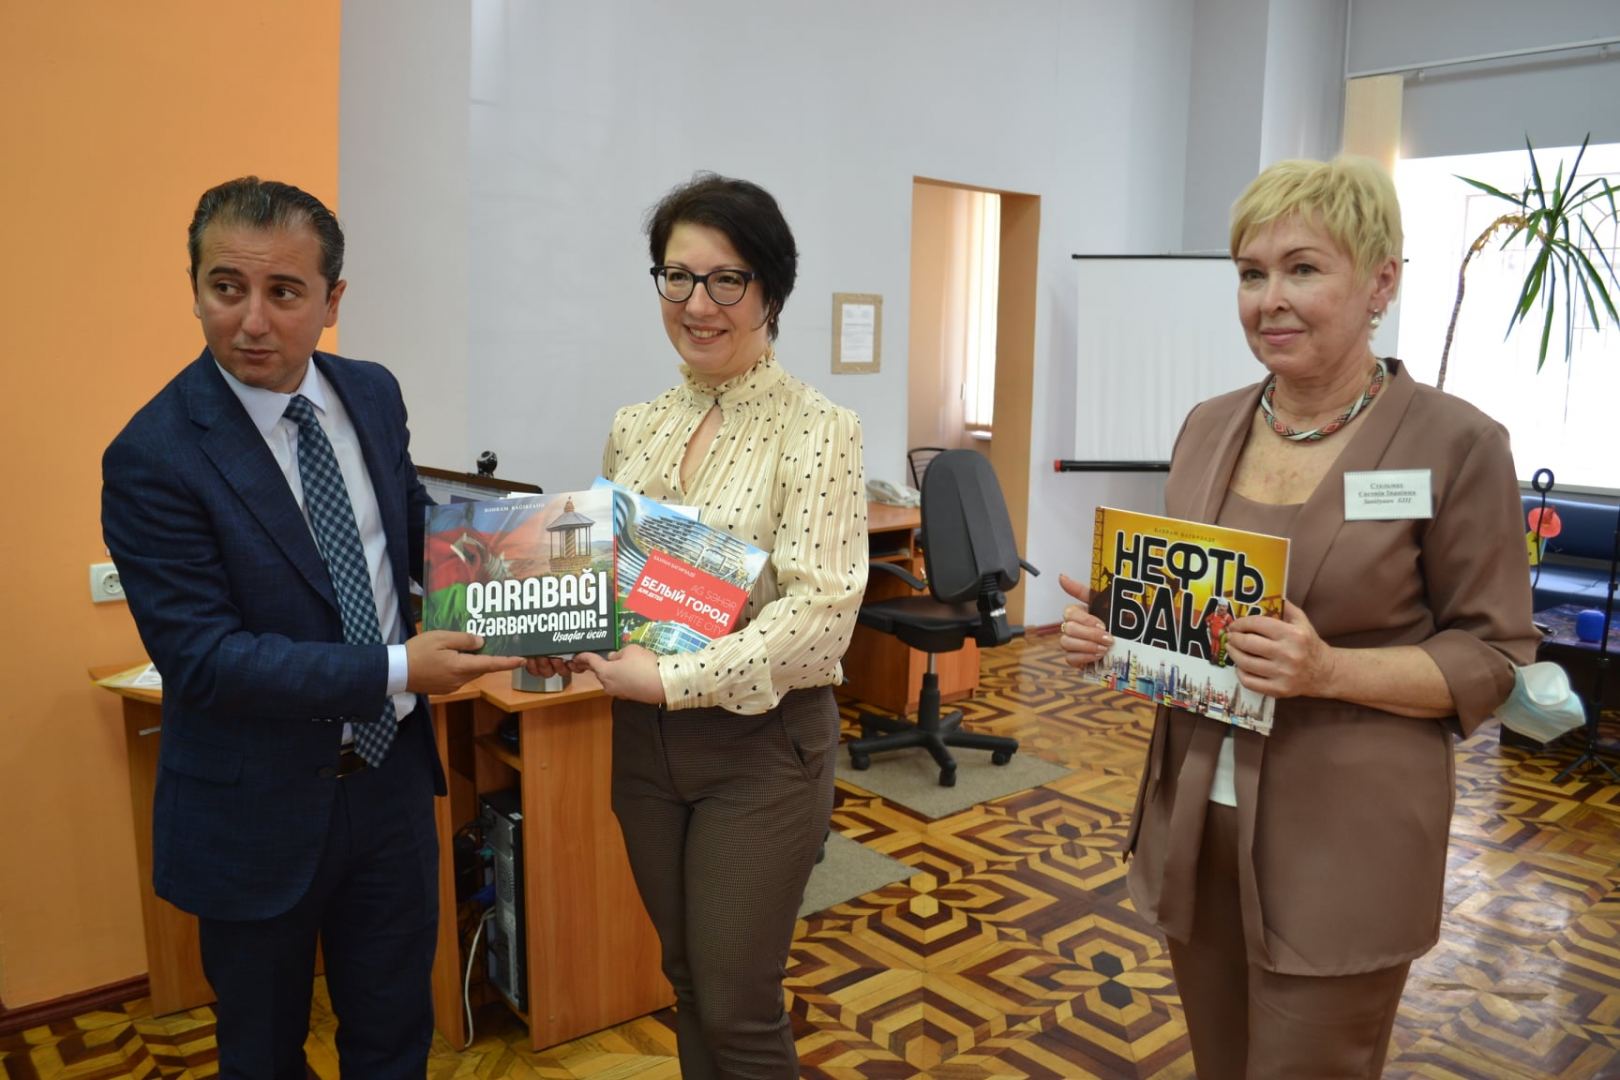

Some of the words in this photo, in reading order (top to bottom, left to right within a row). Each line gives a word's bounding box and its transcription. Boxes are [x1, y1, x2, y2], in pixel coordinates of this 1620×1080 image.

[1114, 530, 1264, 604] НЕФТЬ
[640, 575, 686, 604] БЕЛЫЙ
[684, 596, 730, 627] ГОРОД
